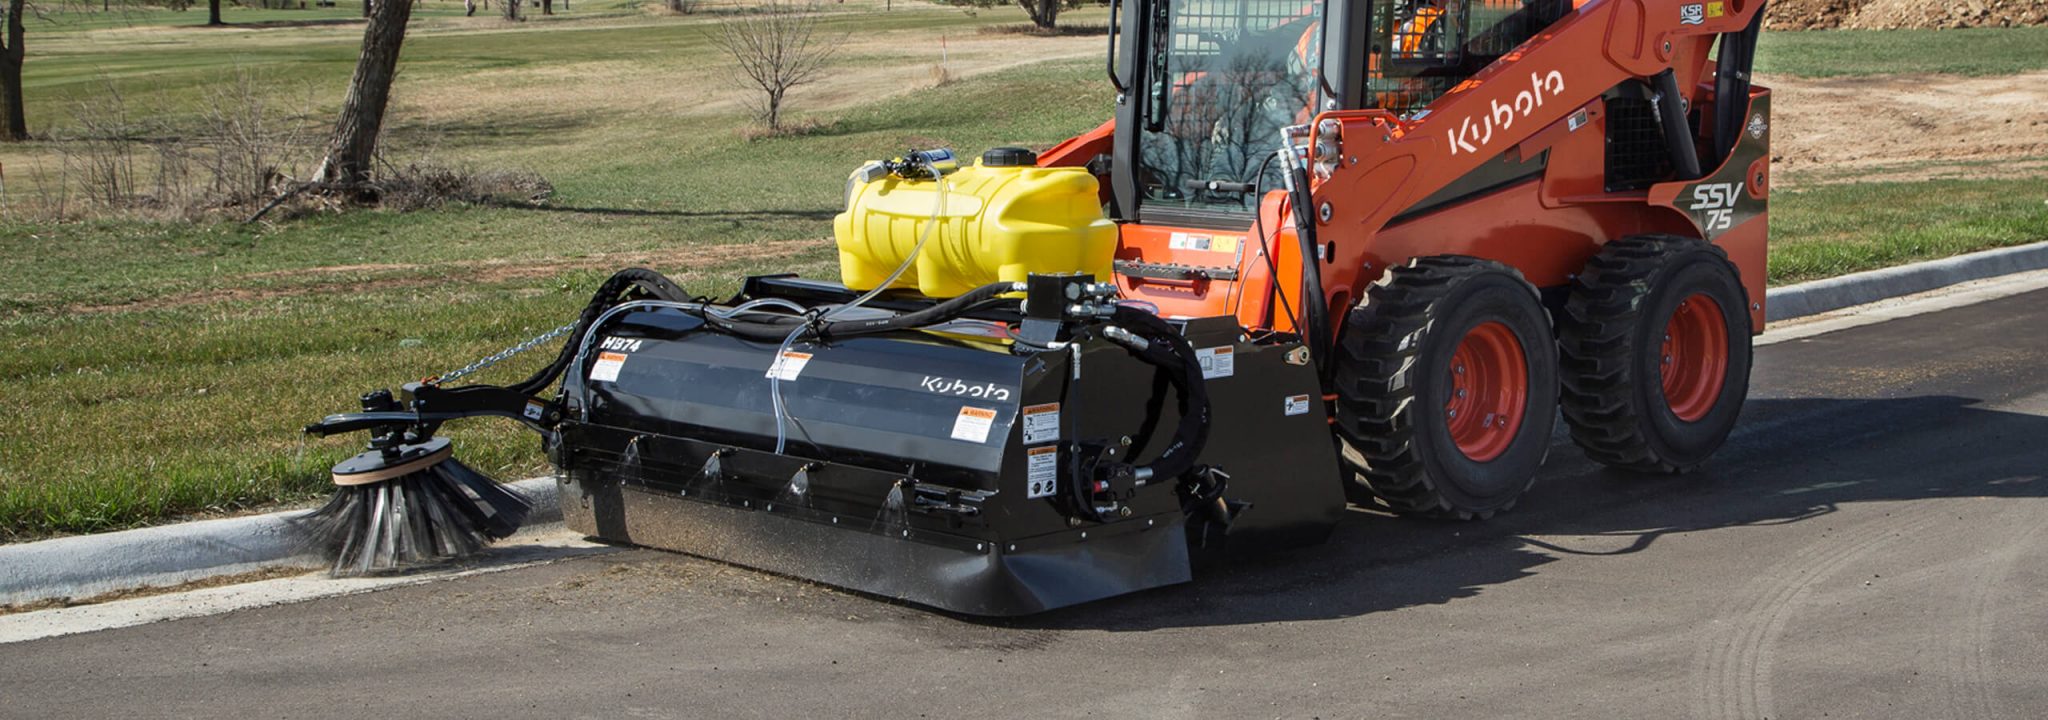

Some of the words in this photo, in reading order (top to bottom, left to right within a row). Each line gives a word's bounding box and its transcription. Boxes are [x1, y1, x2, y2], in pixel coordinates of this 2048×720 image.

[1680, 4, 1703, 17] KSR
[1447, 70, 1565, 155] Kubota
[1690, 181, 1744, 210] SSV
[1706, 208, 1733, 230] 75
[600, 336, 642, 352] HB74
[921, 376, 1009, 401] Kubota
